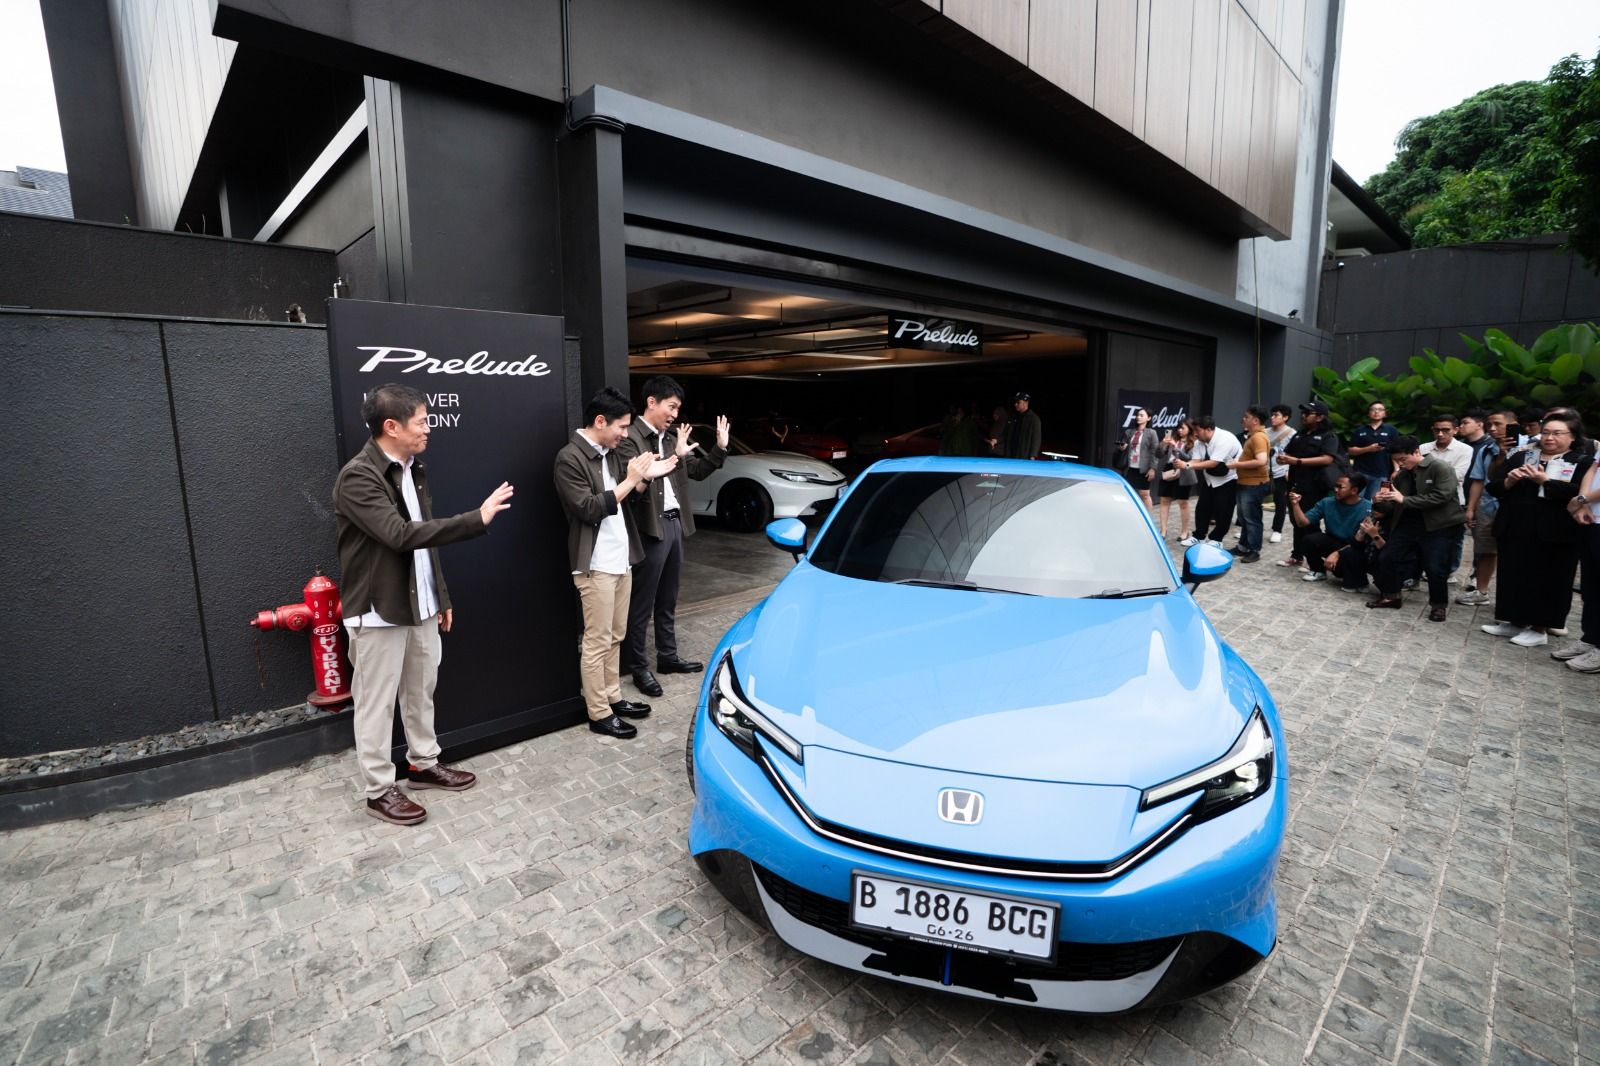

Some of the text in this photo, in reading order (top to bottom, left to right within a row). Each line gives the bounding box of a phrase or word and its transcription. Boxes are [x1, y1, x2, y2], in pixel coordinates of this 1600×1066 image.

[894, 319, 979, 346] Prelude
[356, 346, 551, 376] Prelude
[1122, 405, 1186, 428] Pelud
[320, 635, 341, 694] HYDRANT
[860, 880, 1048, 939] B 1886 BCG
